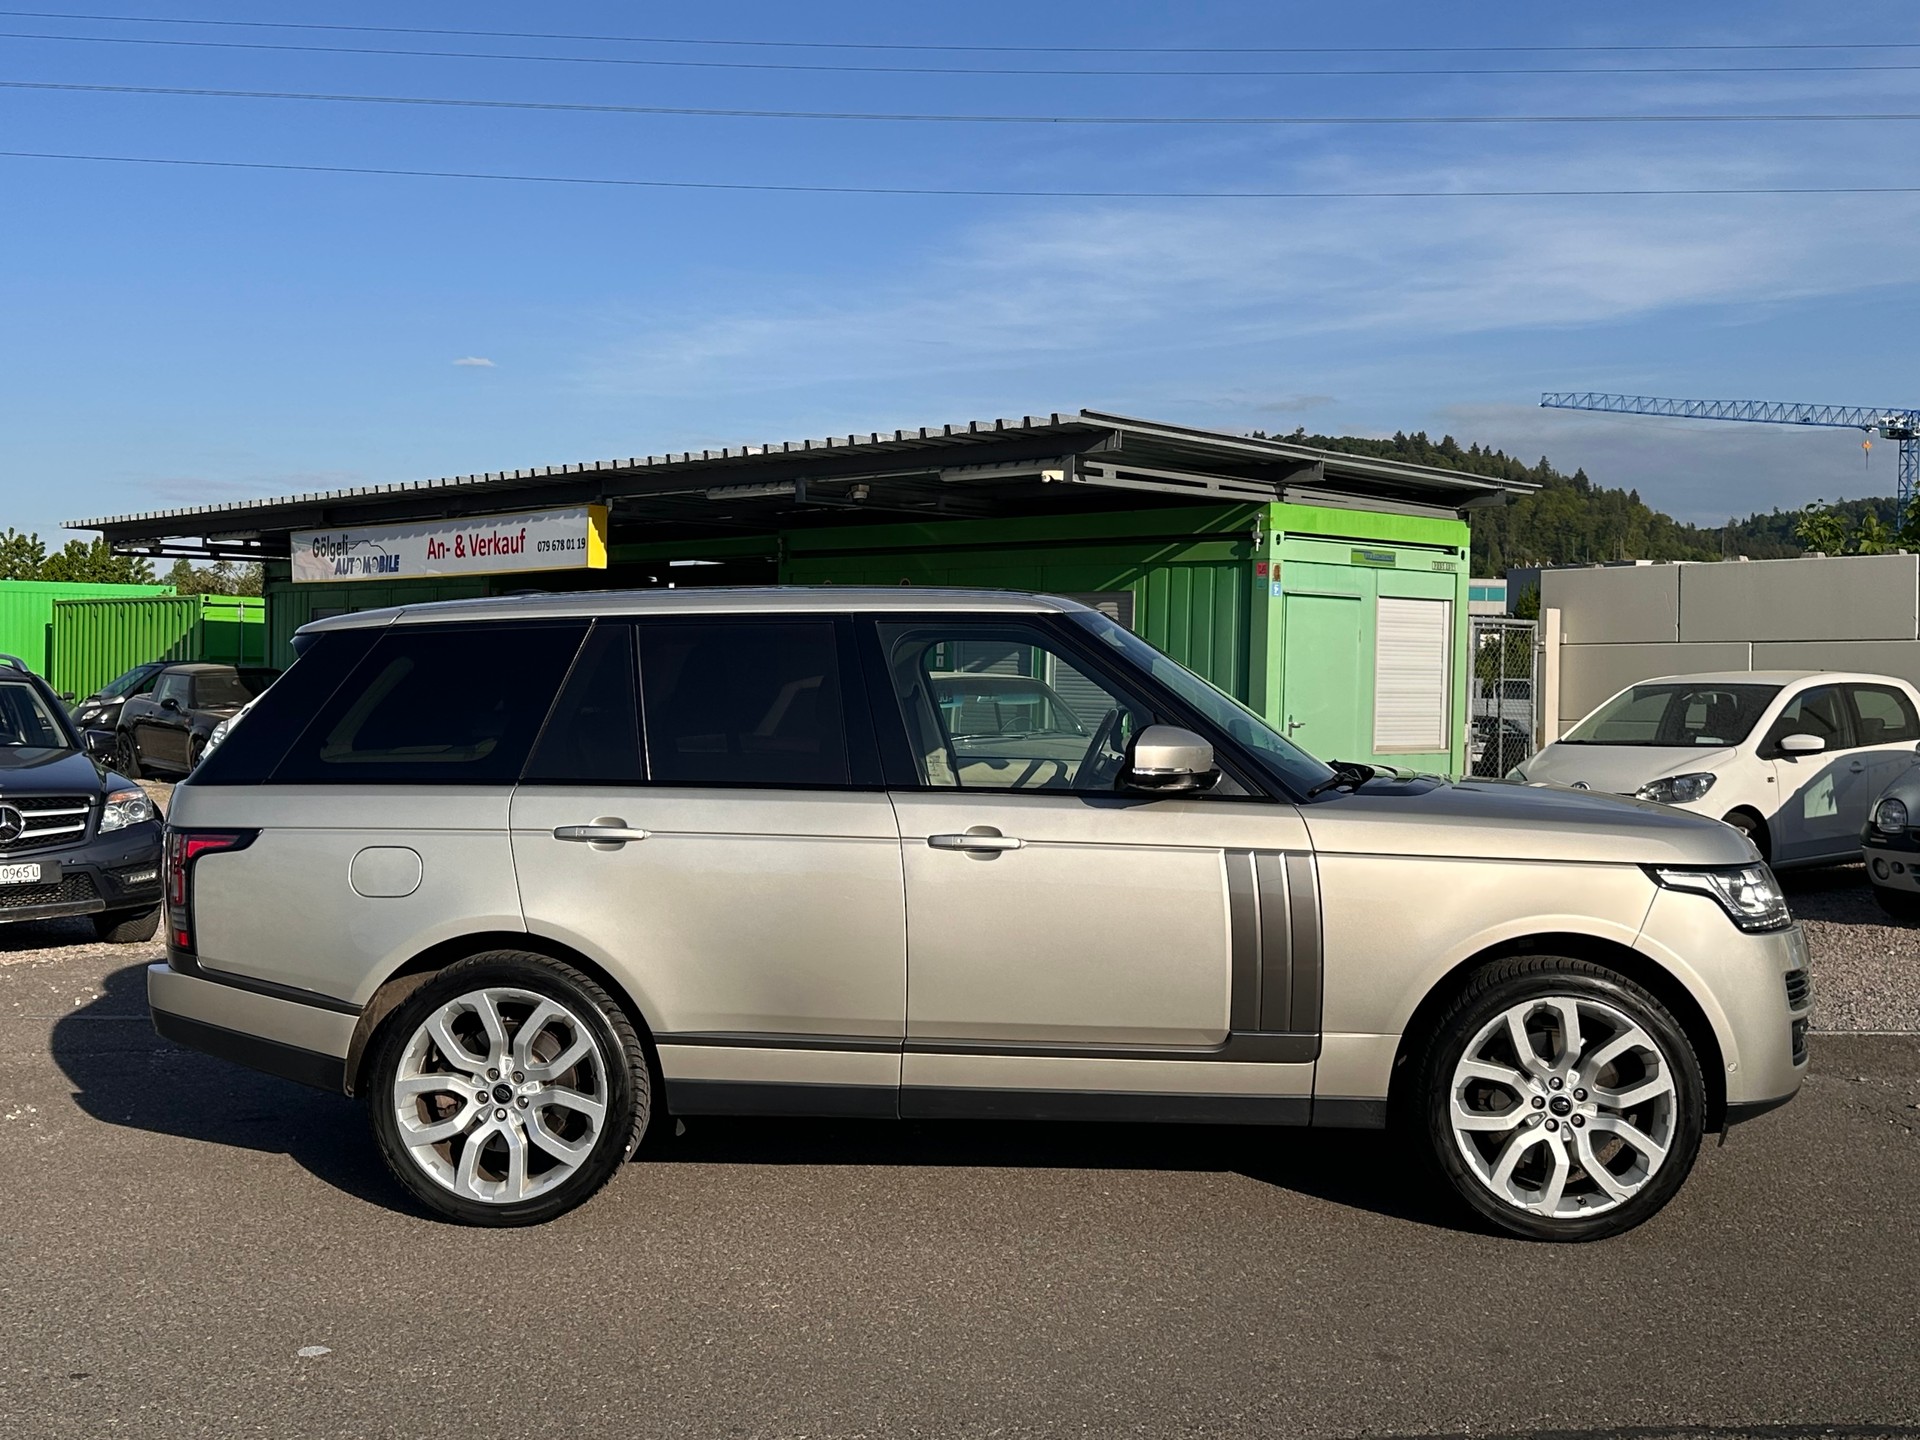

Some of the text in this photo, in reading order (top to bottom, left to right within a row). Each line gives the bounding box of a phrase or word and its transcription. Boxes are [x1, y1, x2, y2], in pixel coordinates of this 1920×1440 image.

[312, 534, 349, 562] Gölgeli
[427, 528, 526, 560] An- & Verkauf
[537, 537, 586, 553] 079 678 01 19
